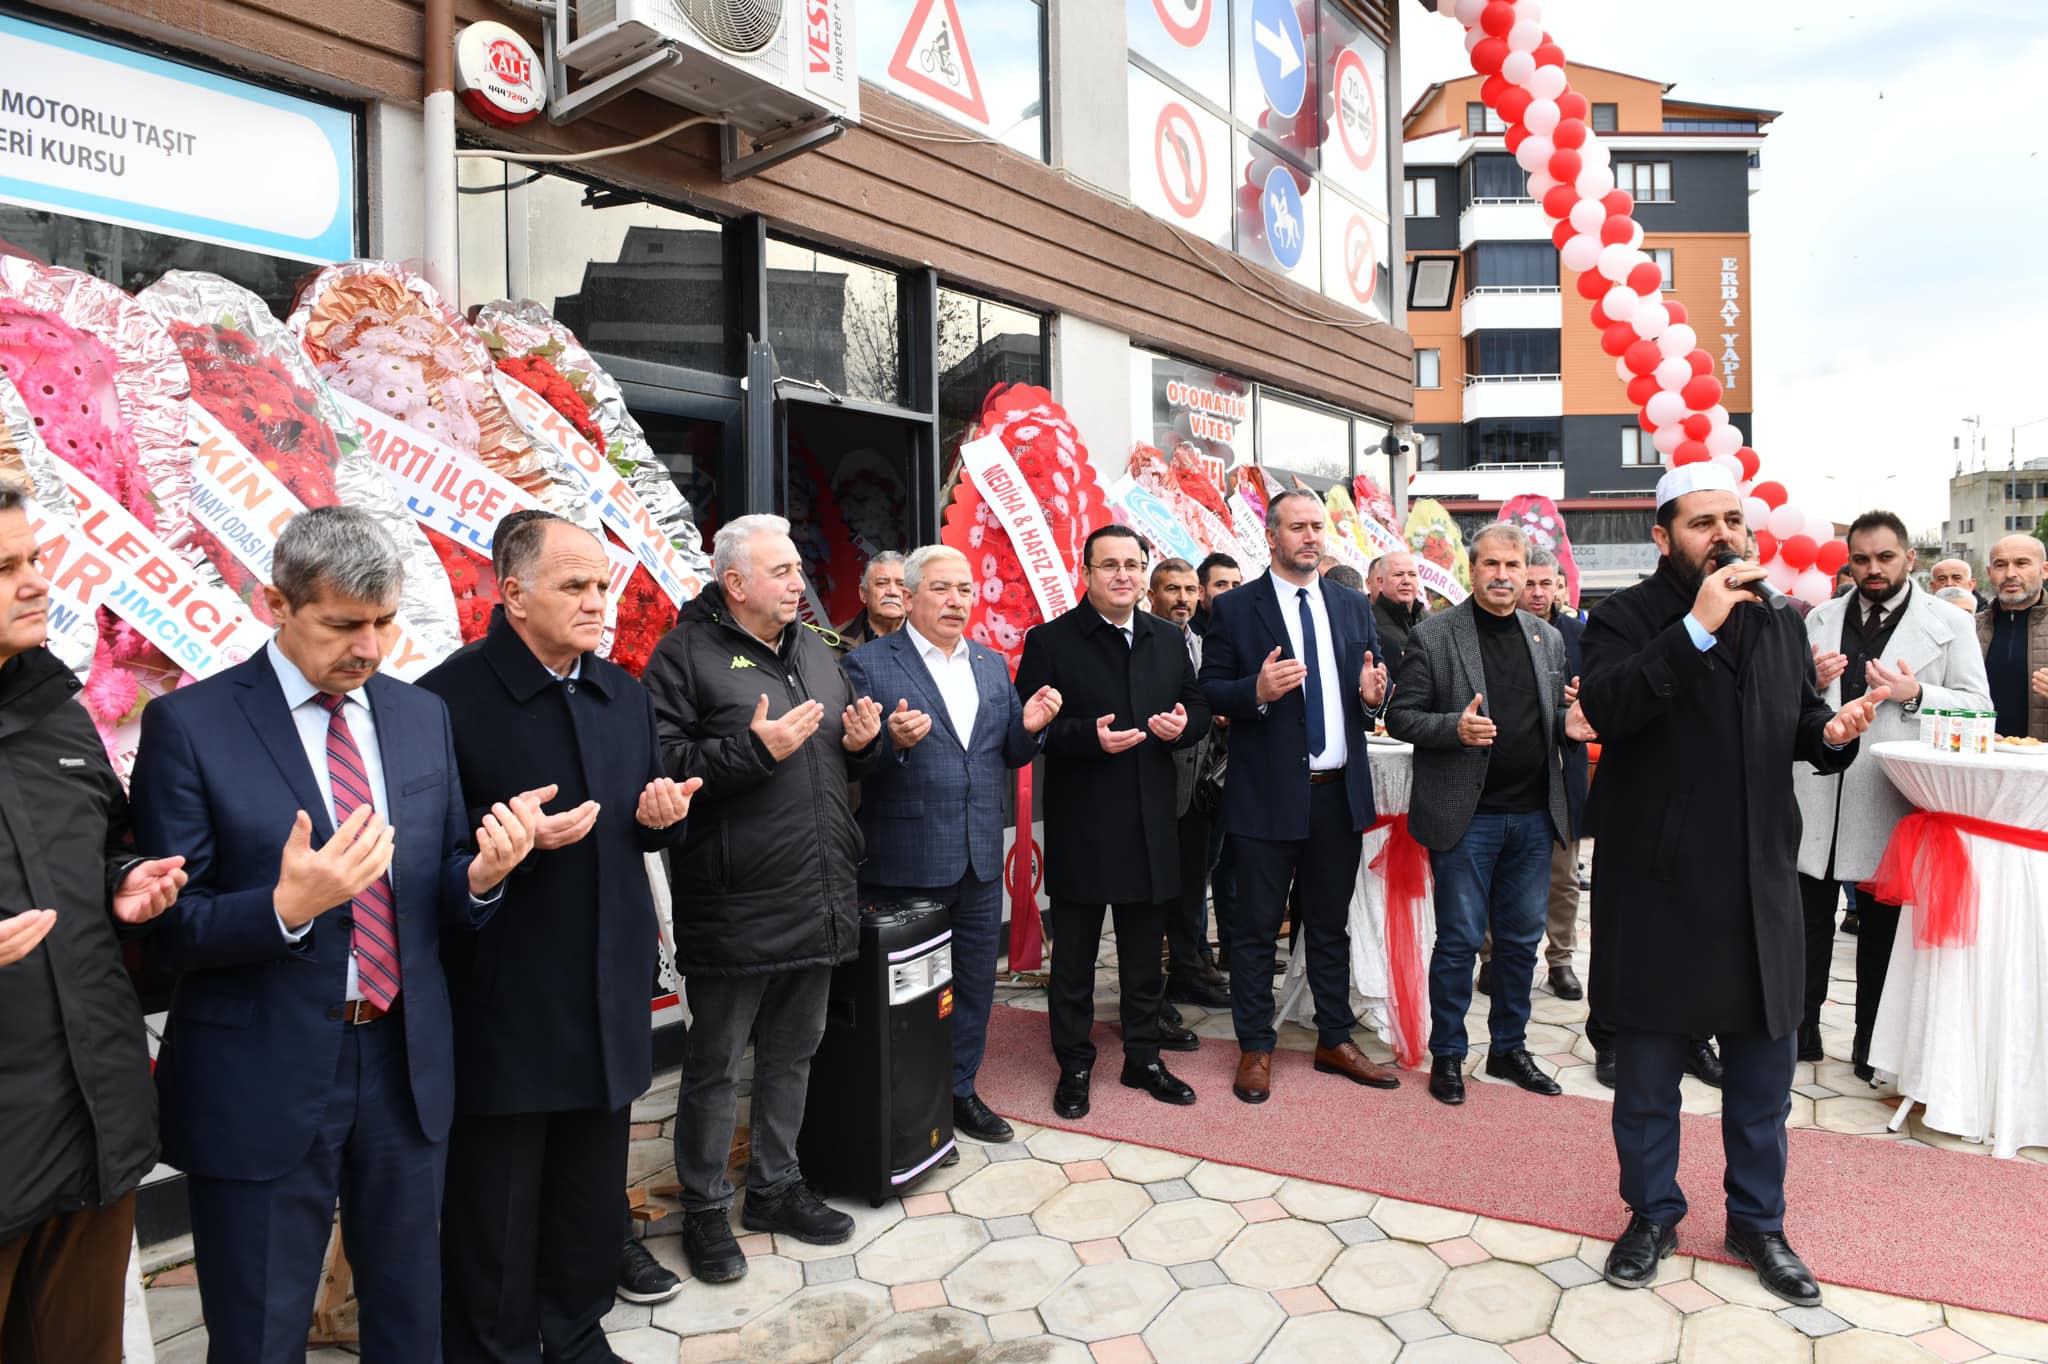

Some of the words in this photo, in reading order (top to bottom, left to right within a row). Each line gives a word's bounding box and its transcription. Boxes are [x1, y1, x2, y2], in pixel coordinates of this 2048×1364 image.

[806, 0, 830, 73] VES
[833, 13, 844, 82] inverter
[484, 48, 531, 83] KALE
[1, 88, 127, 139] MOTORLU
[132, 120, 197, 157] TAŞIT
[41, 137, 126, 177] KURSU
[1720, 257, 1741, 327] ERBAY
[1720, 333, 1741, 389] YAPI
[1167, 381, 1248, 418] OTOMATİK
[1190, 412, 1234, 443] VİTES
[197, 420, 273, 512] KİN
[431, 455, 507, 526] İLÇE
[981, 463, 1024, 516] MEDİHA
[221, 515, 267, 559] ODASI
[608, 478, 703, 600] EMLA
[1012, 515, 1034, 529] &
[30, 517, 113, 605] AR
[1019, 527, 1055, 575] HAFIZ
[1038, 575, 1070, 621] AHME
[1417, 564, 1448, 589] RDAR
[48, 597, 80, 634] NI
